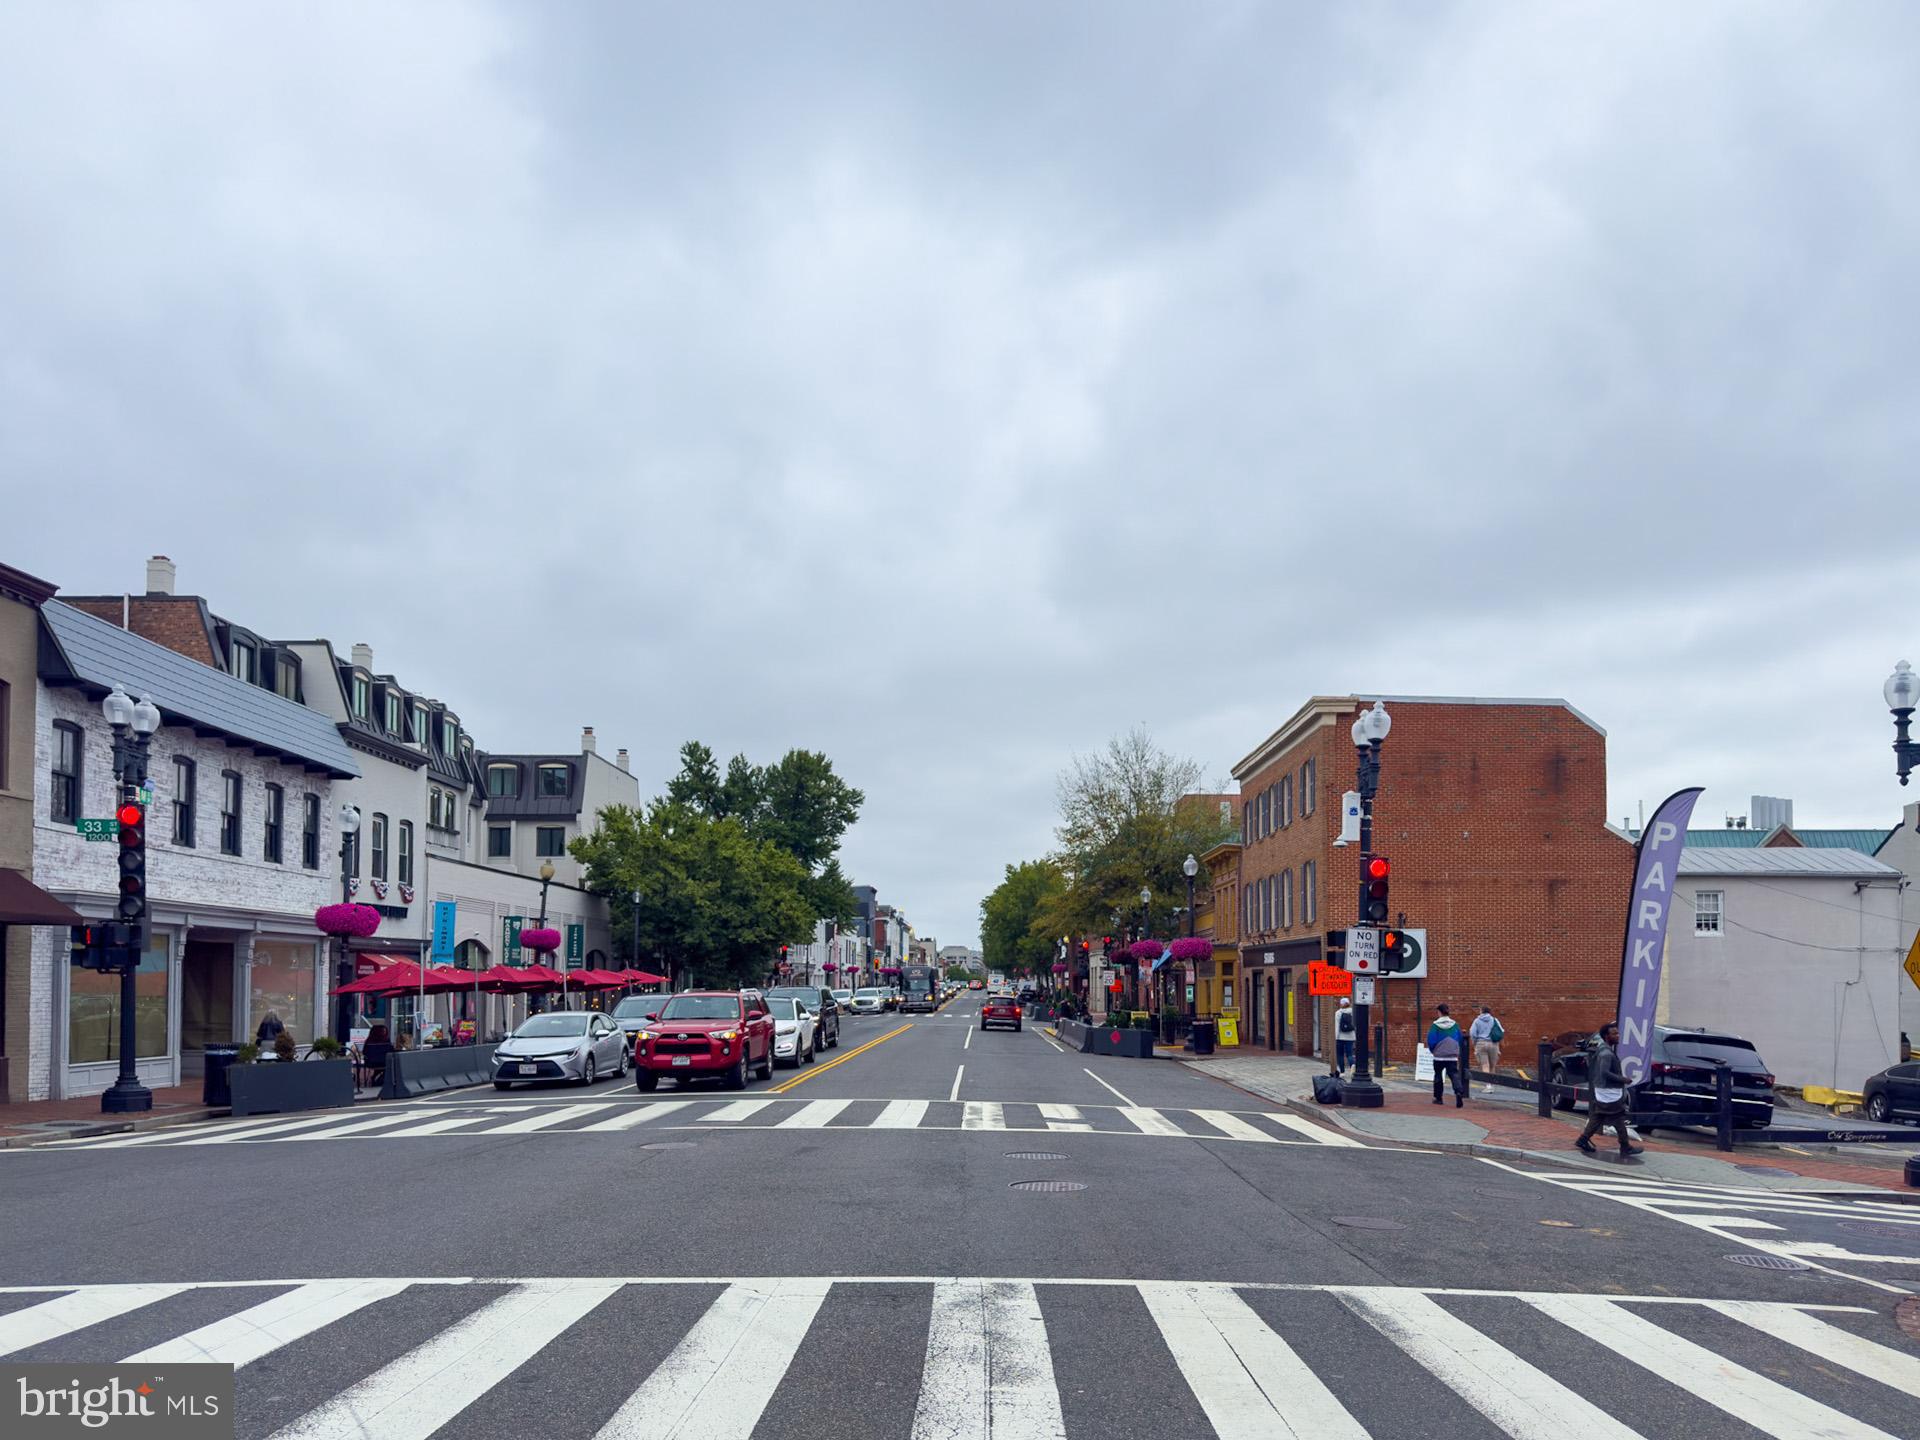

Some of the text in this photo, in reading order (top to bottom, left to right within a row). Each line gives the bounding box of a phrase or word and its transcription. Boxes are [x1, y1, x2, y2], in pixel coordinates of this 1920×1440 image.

[84, 821, 102, 832] 33
[88, 833, 111, 841] 1200
[1357, 931, 1372, 941] NO
[1354, 941, 1375, 950] TURN
[1349, 950, 1378, 960] ON RED
[1620, 821, 1677, 1086] PARKING
[1321, 981, 1348, 989] DETOUR
